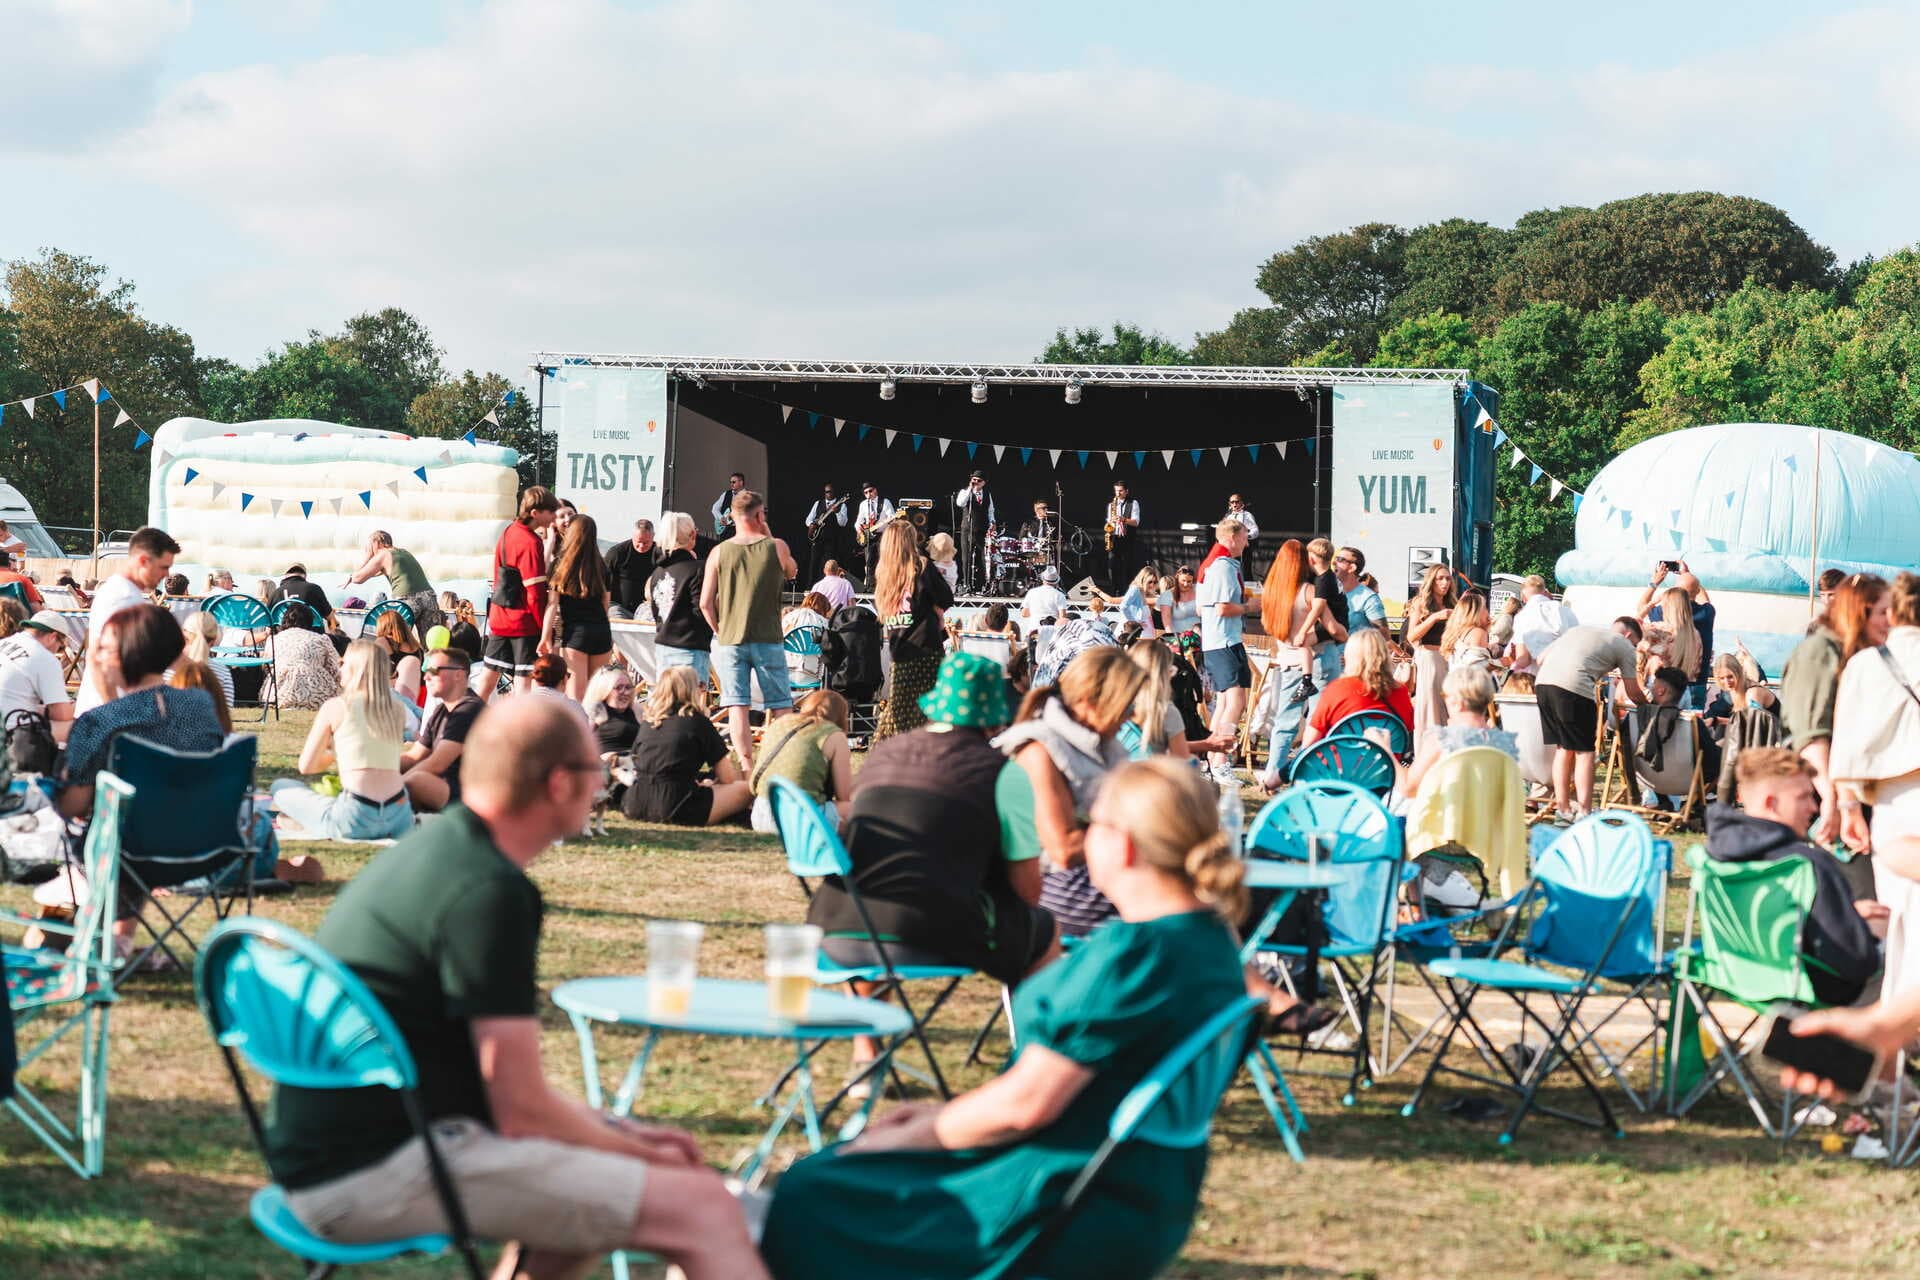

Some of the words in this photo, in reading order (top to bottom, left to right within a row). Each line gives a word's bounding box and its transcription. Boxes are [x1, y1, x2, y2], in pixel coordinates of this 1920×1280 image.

[592, 429, 608, 440] LIVE
[608, 429, 631, 441] MUSIC
[1371, 449, 1389, 461] LIVE
[1390, 449, 1415, 461] MUSIC
[567, 452, 656, 492] TASTY.
[1357, 475, 1437, 514] YUM.
[885, 613, 914, 626] LOVE
